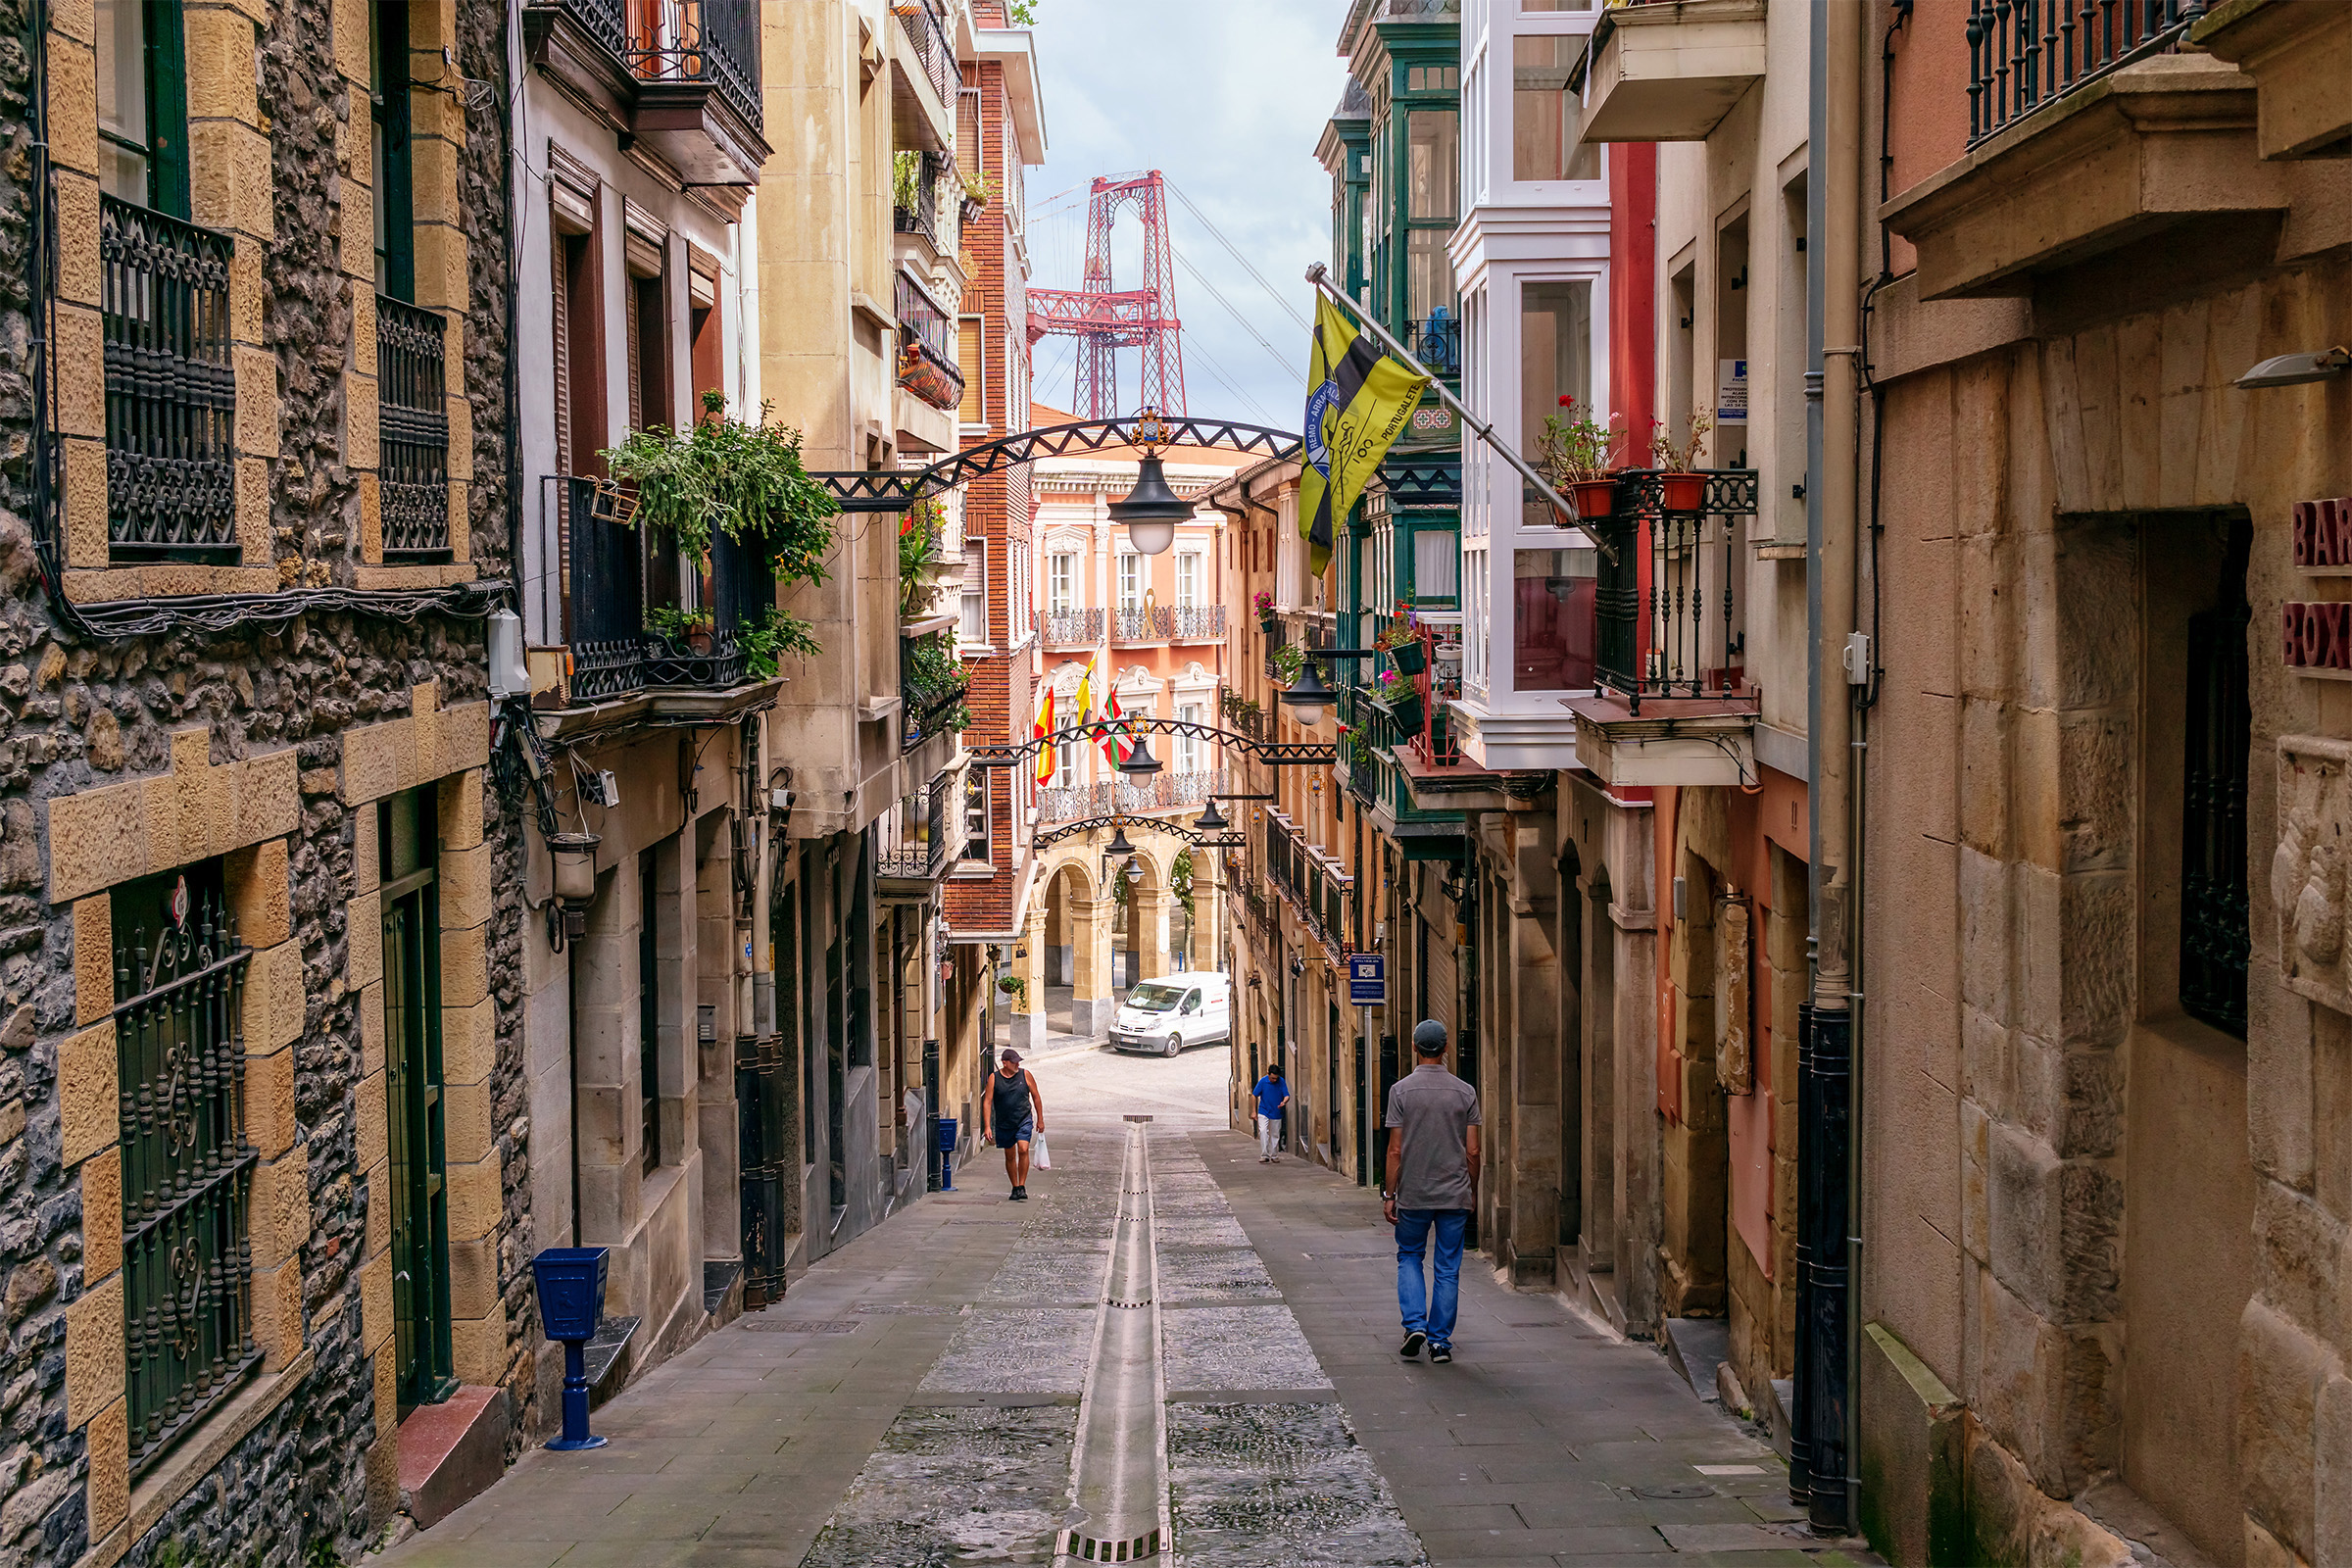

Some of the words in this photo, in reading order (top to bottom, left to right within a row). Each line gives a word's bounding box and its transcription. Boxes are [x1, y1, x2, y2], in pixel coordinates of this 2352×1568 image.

[1381, 383, 1421, 441] PORTUGALETE
[1308, 425, 1318, 451] REMO
[1352, 438, 1374, 465] 100
[2282, 603, 2352, 669] BOX
